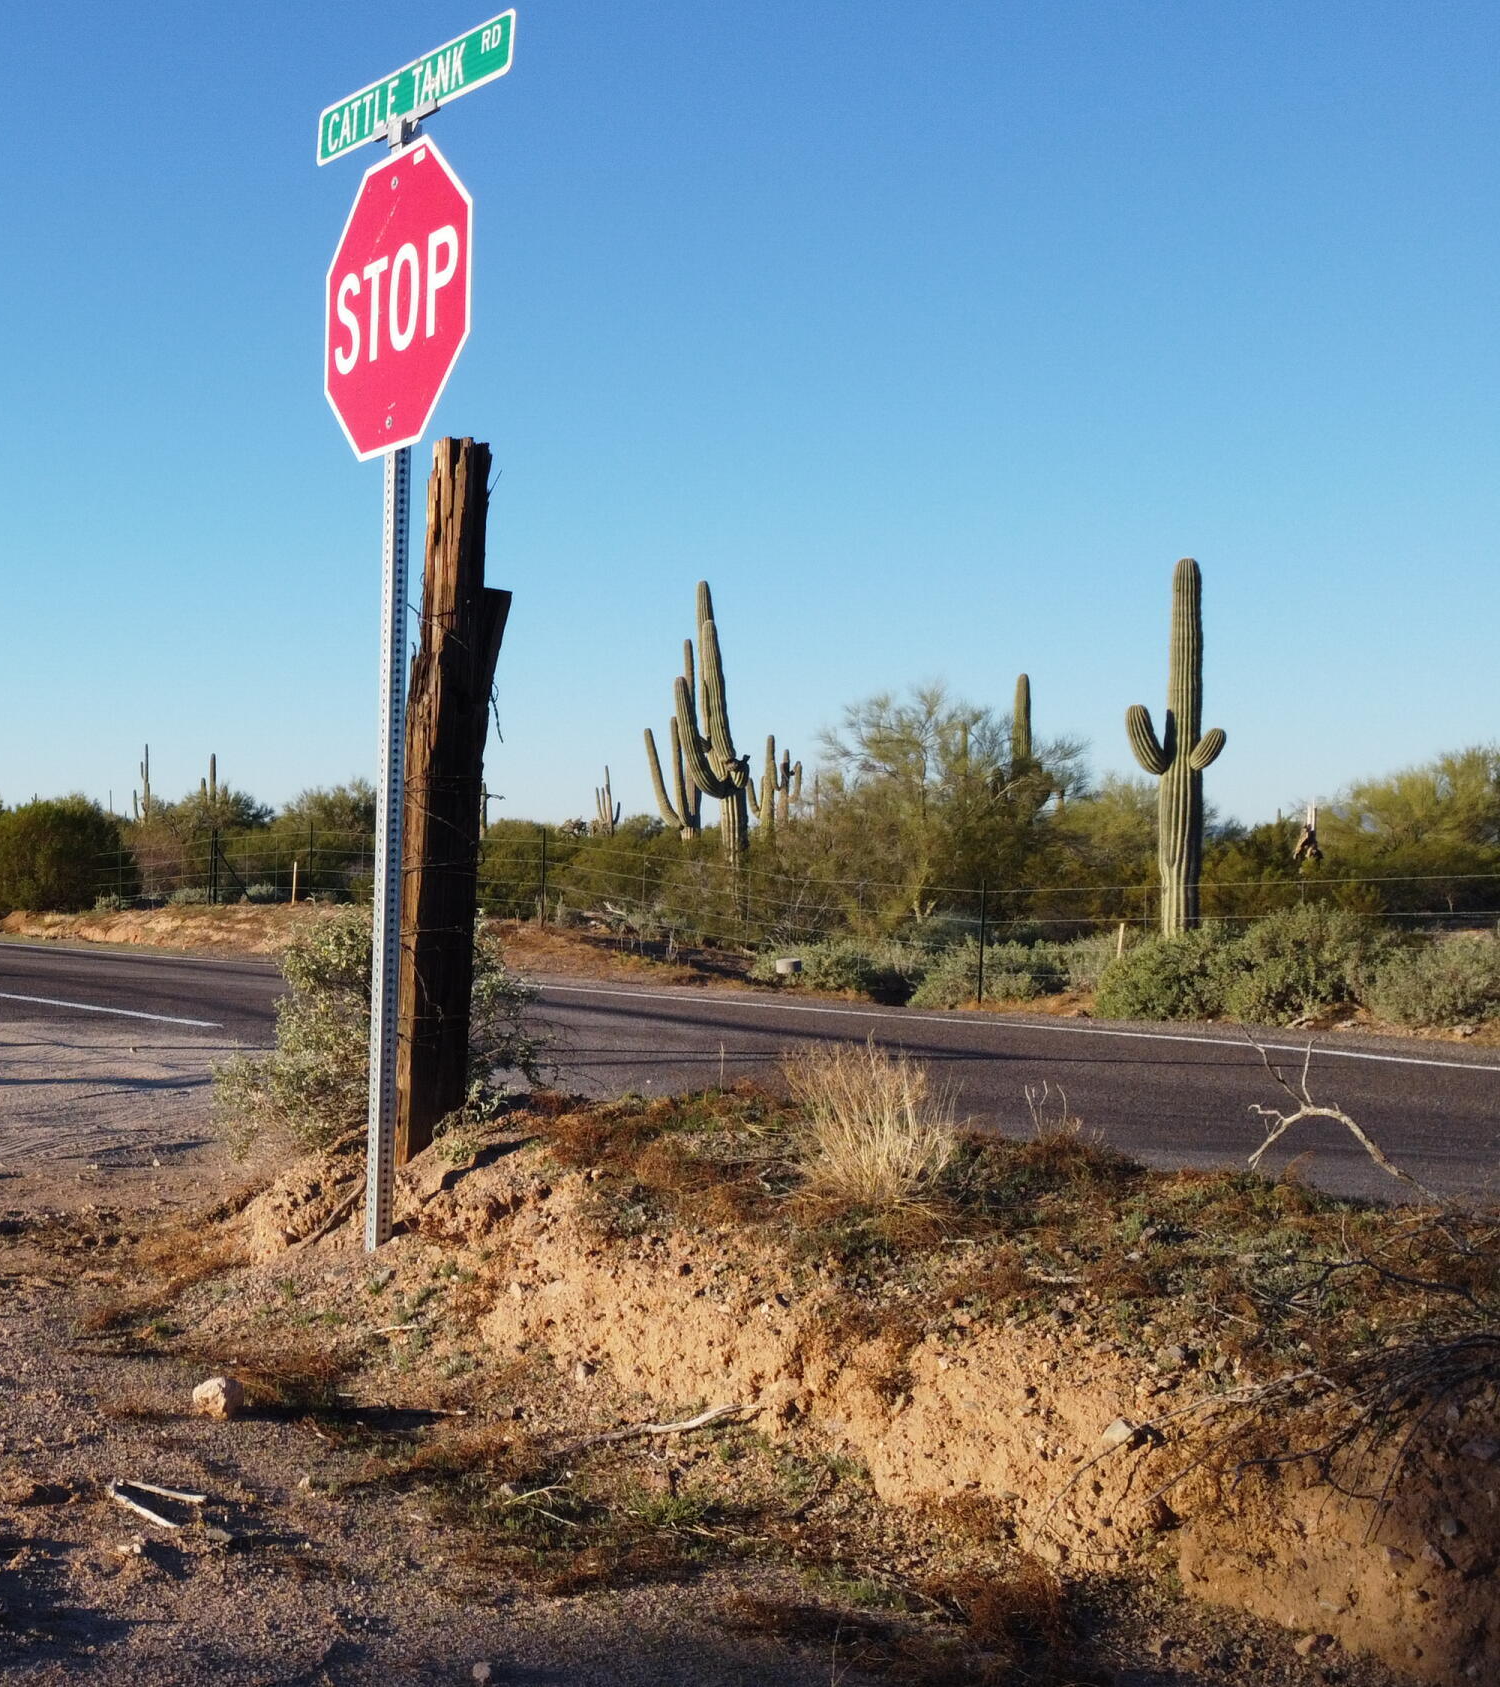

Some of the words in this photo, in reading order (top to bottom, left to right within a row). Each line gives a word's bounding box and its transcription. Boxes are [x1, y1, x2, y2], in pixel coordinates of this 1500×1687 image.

[327, 79, 400, 153] CATTLE
[412, 42, 467, 110] TANK
[480, 24, 502, 55] RD
[334, 224, 459, 375] STOP
